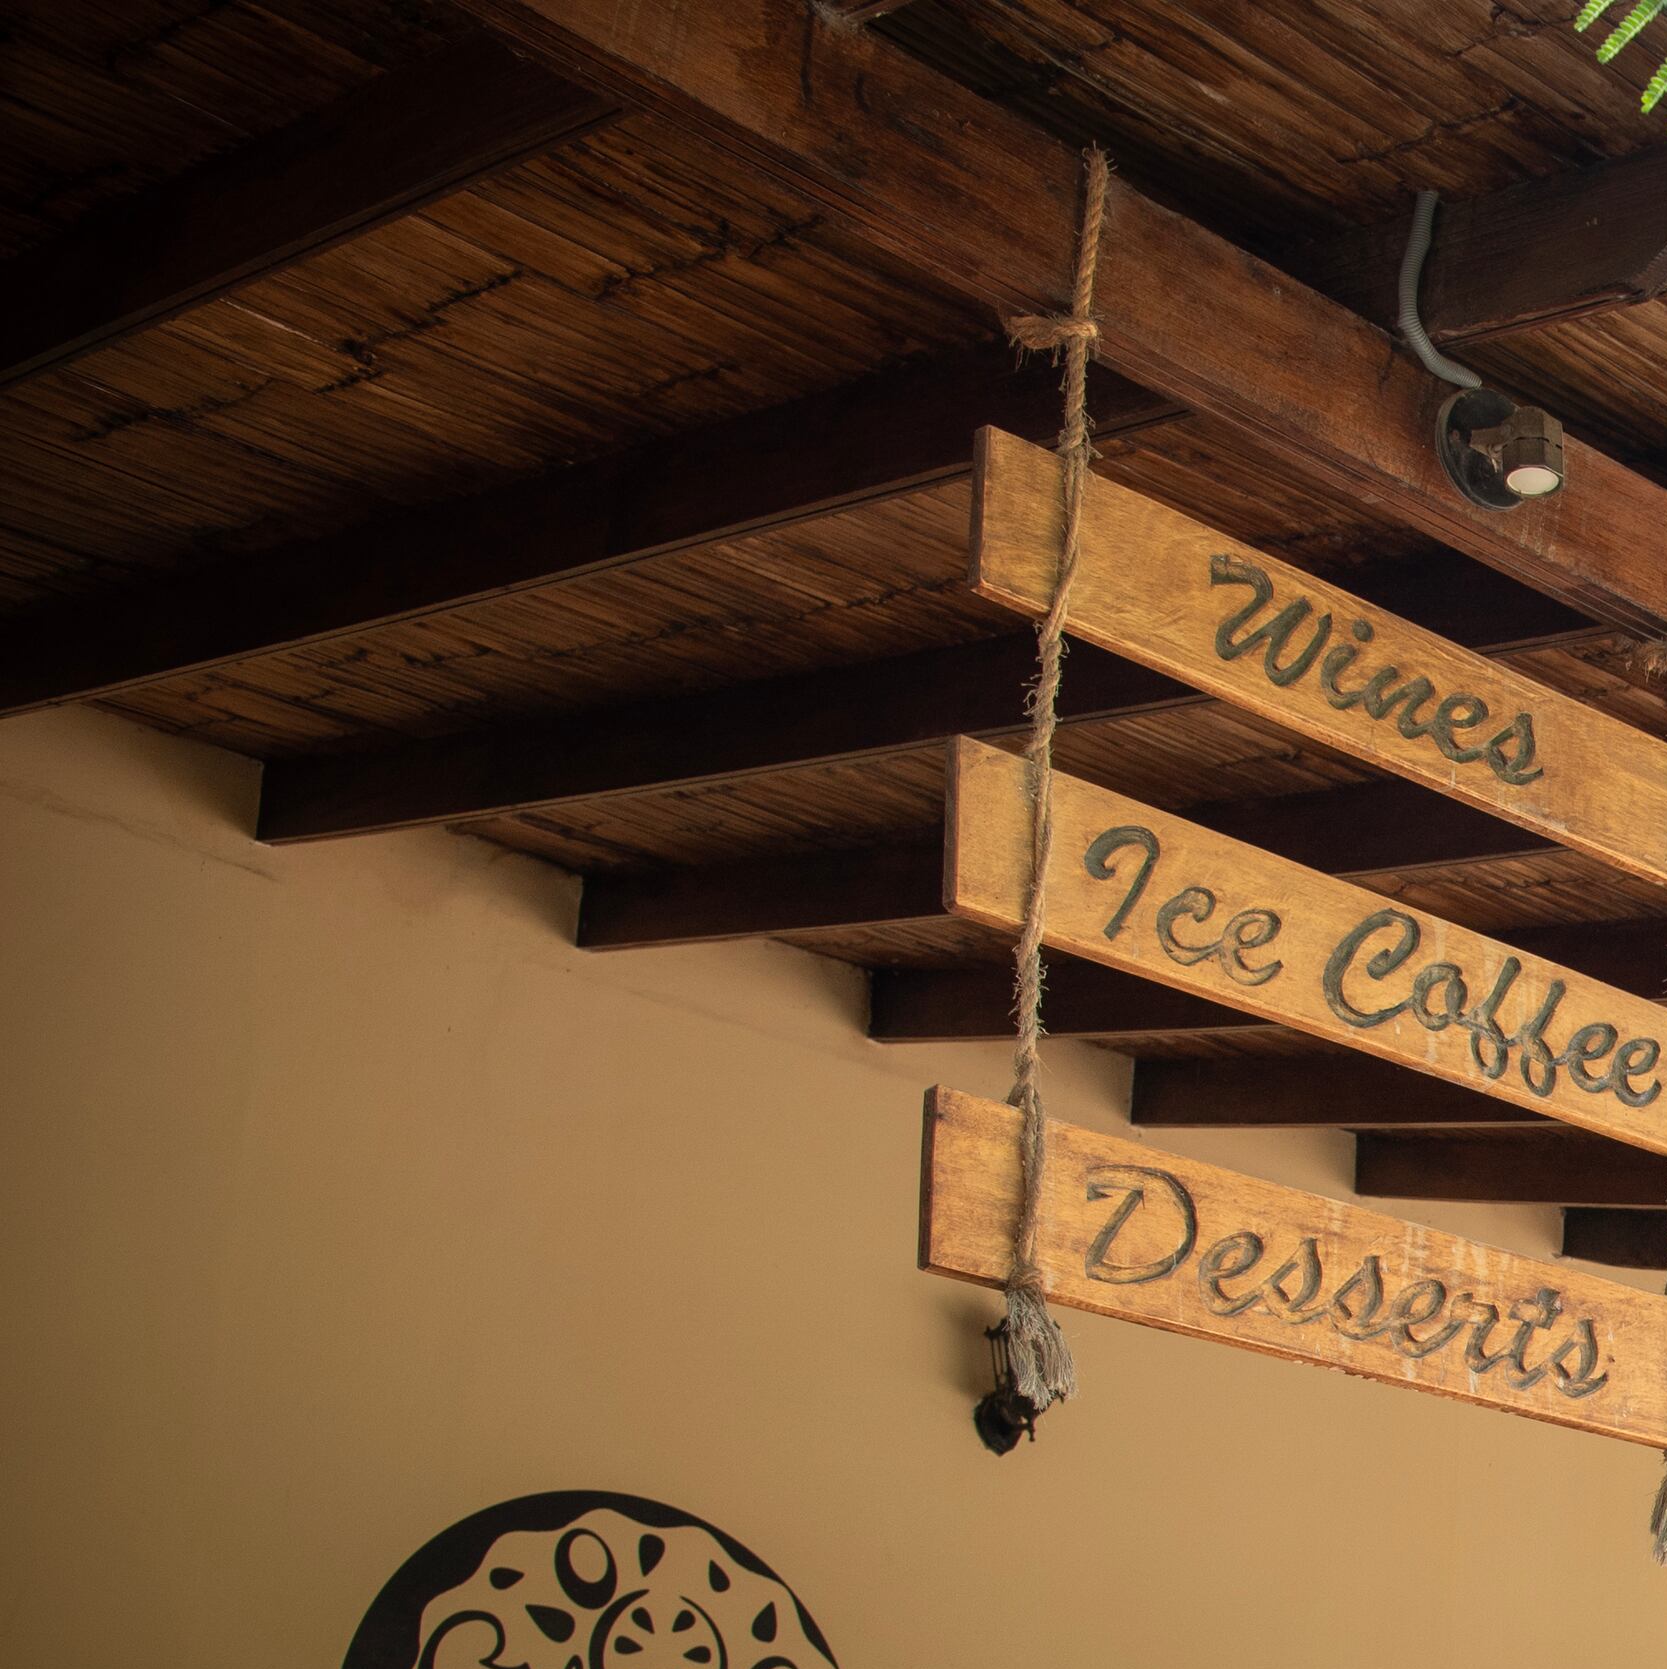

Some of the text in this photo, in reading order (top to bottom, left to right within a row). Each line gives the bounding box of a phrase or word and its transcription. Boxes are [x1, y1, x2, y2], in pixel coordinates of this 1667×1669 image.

[1209, 554, 1544, 786] Wines
[1084, 825, 1664, 1108] Ice Coffee
[1085, 1165, 1611, 1399] Desserts
